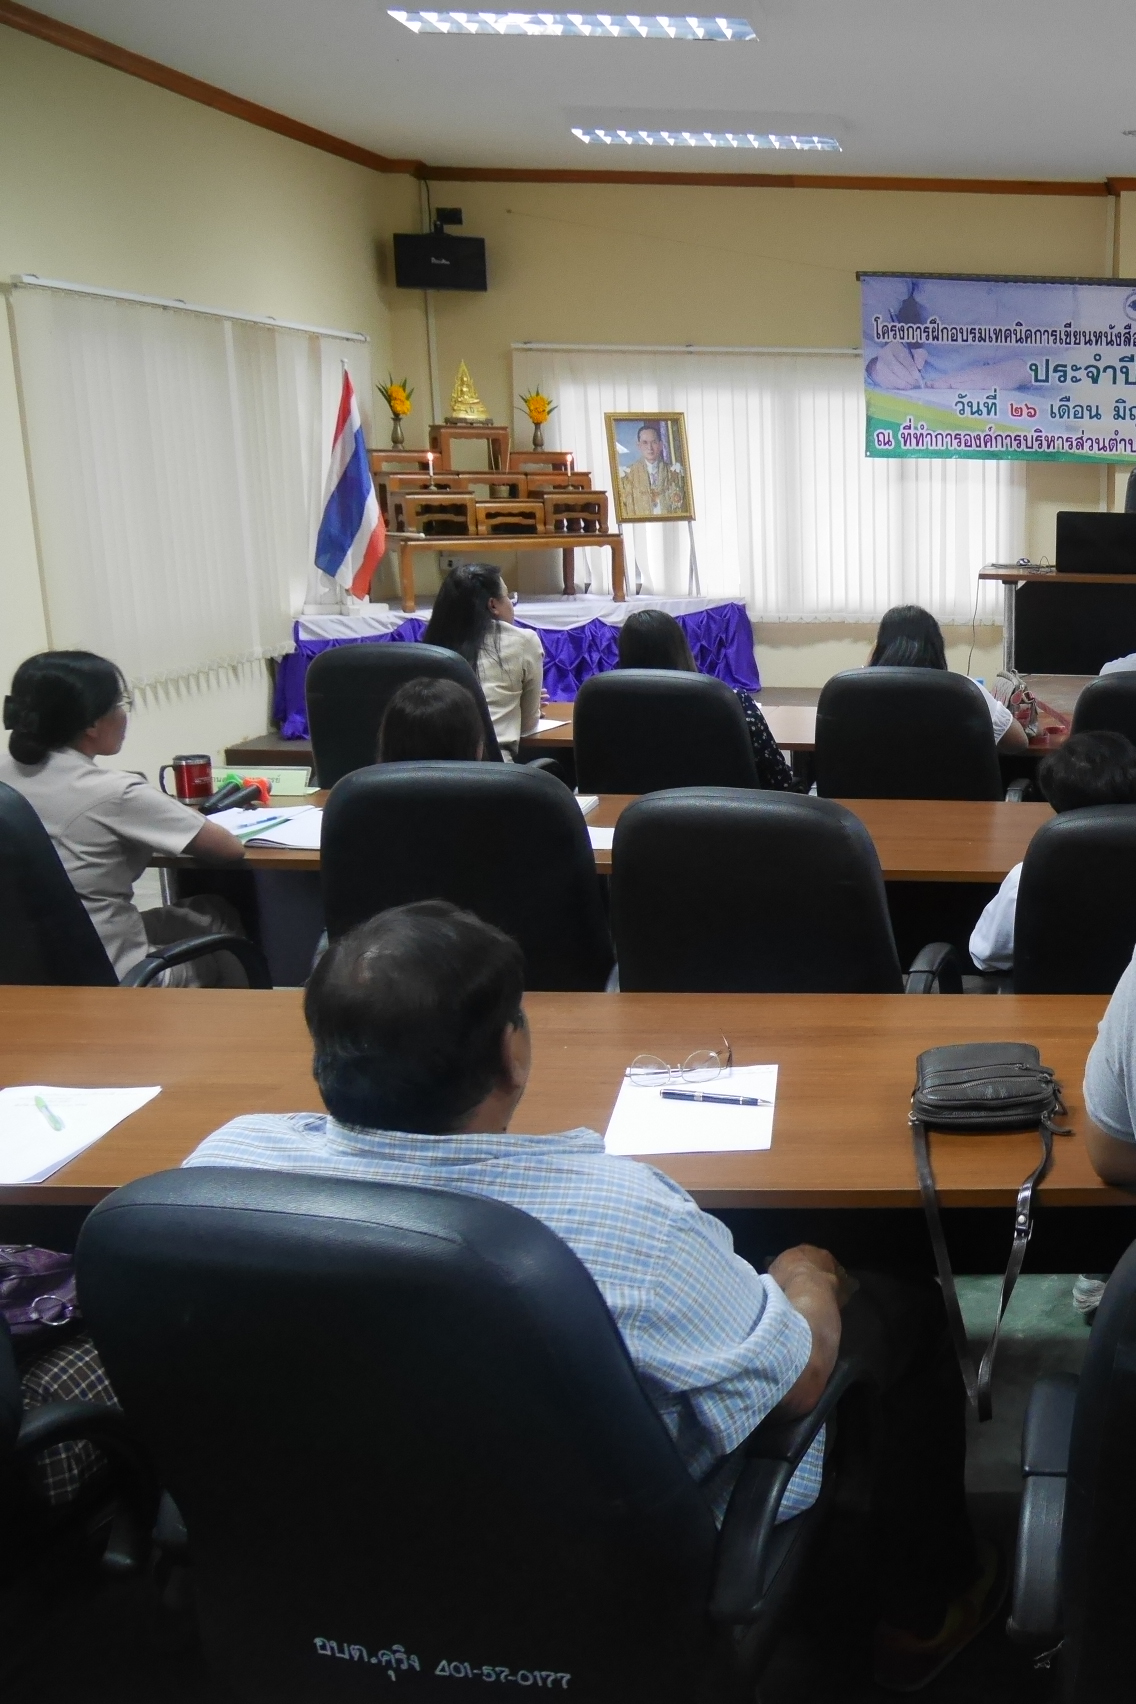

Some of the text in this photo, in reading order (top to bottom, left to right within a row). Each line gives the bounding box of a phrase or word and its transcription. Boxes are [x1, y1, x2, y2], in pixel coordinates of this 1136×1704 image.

[955, 388, 998, 417] วันที่
[1009, 402, 1038, 418] ๒๖
[1050, 395, 1102, 421] เดือน
[874, 431, 893, 448] ณ
[313, 1637, 420, 1681] อบต.คุริง
